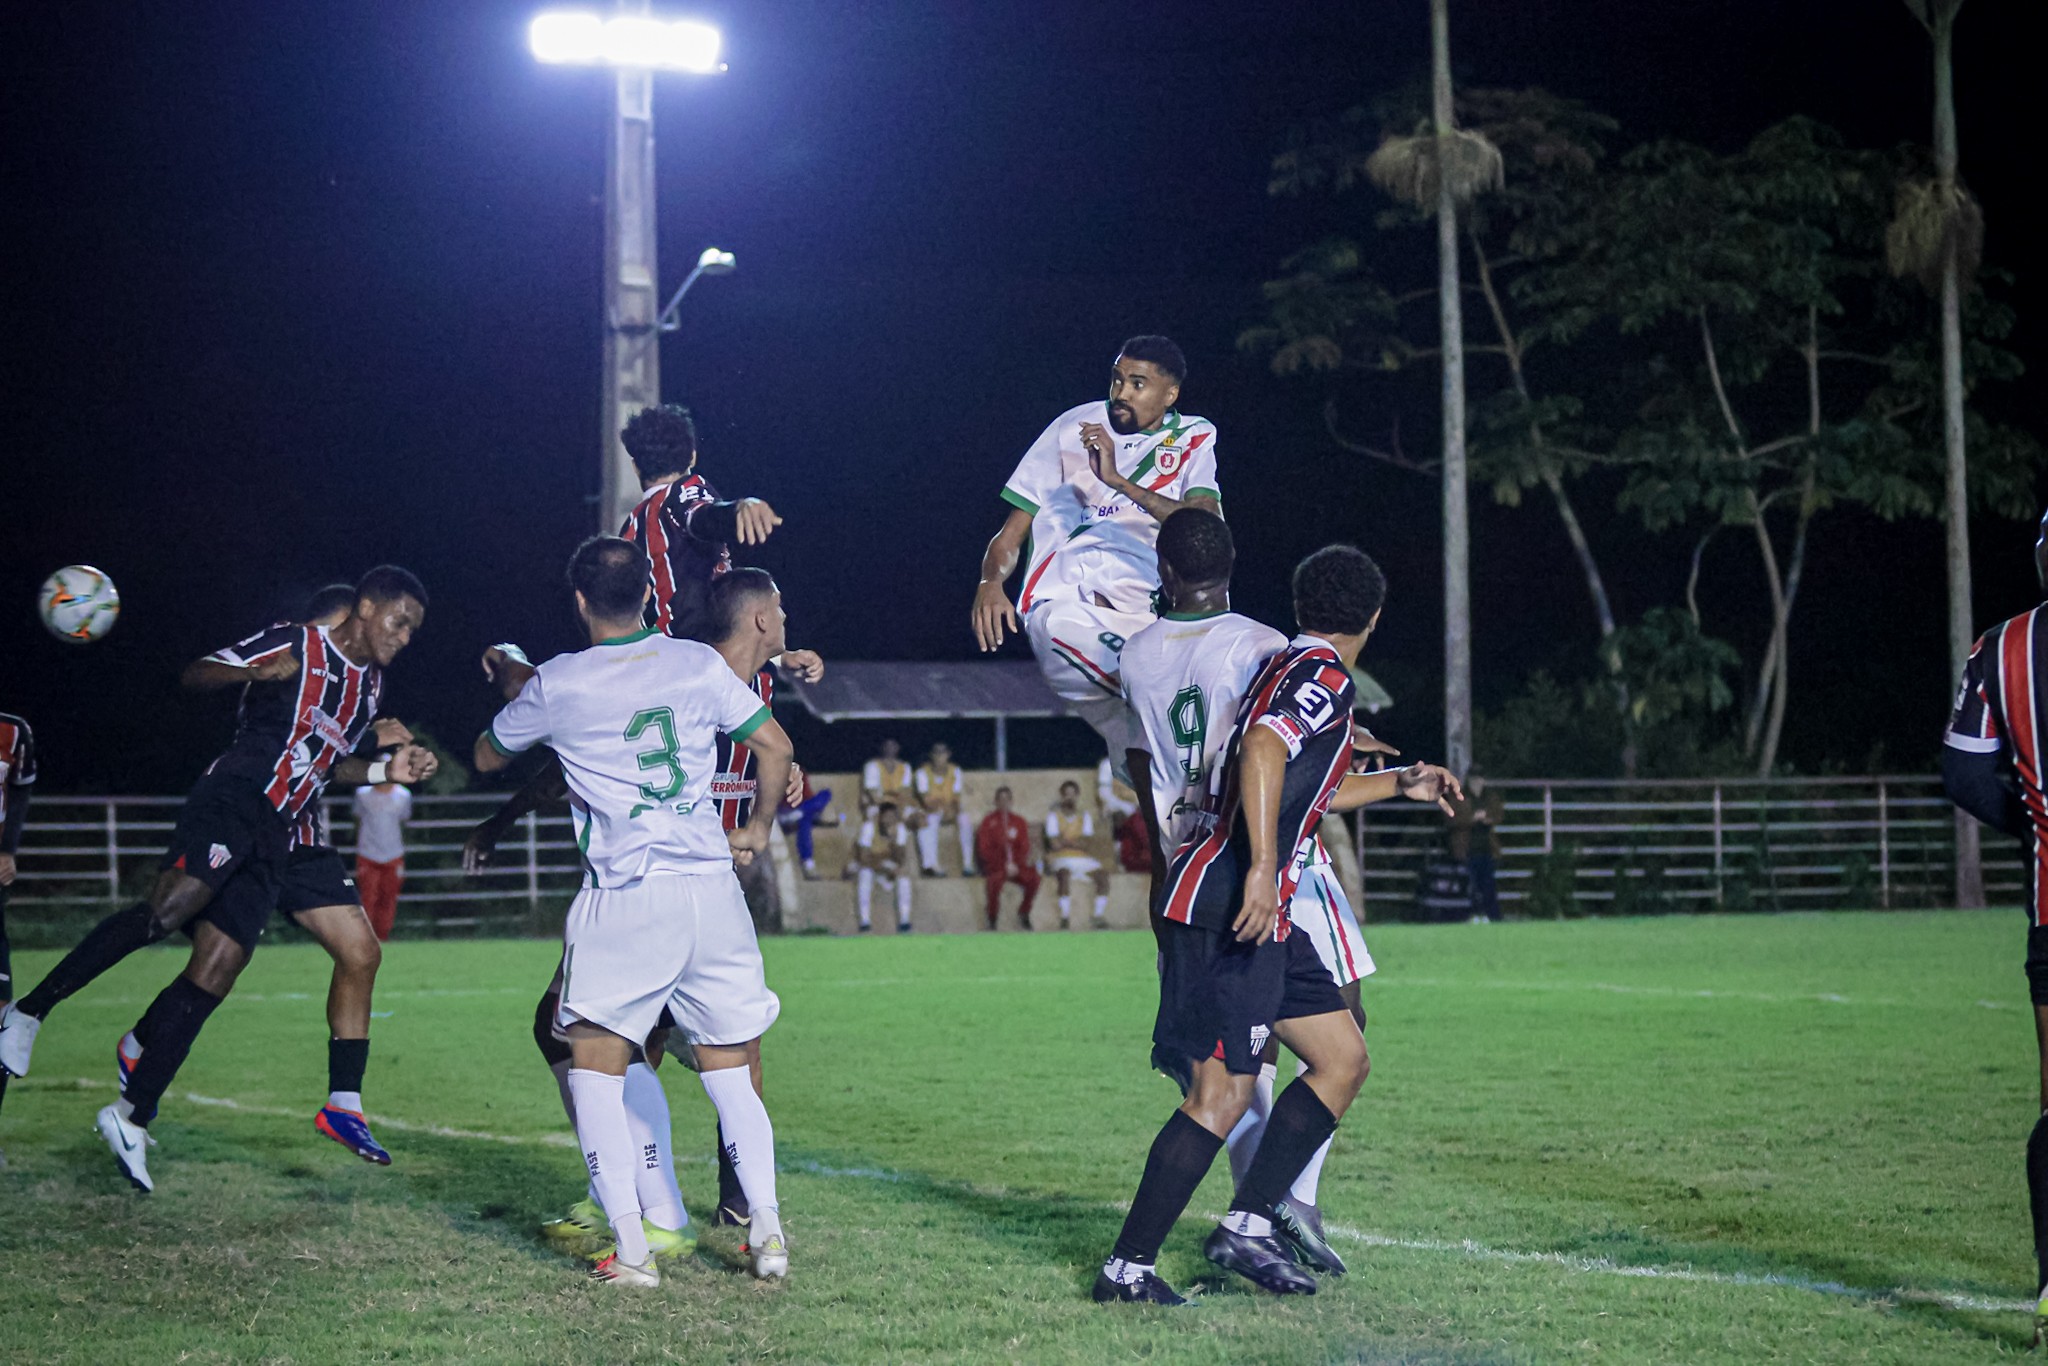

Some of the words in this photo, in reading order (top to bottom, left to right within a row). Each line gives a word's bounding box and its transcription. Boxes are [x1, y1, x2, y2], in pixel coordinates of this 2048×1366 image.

[1098, 631, 1126, 653] 8
[1167, 684, 1206, 787] 9
[623, 706, 689, 803] 3
[587, 1151, 601, 1178] FASE
[644, 1143, 660, 1170] FASE
[726, 1142, 741, 1169] FASE
